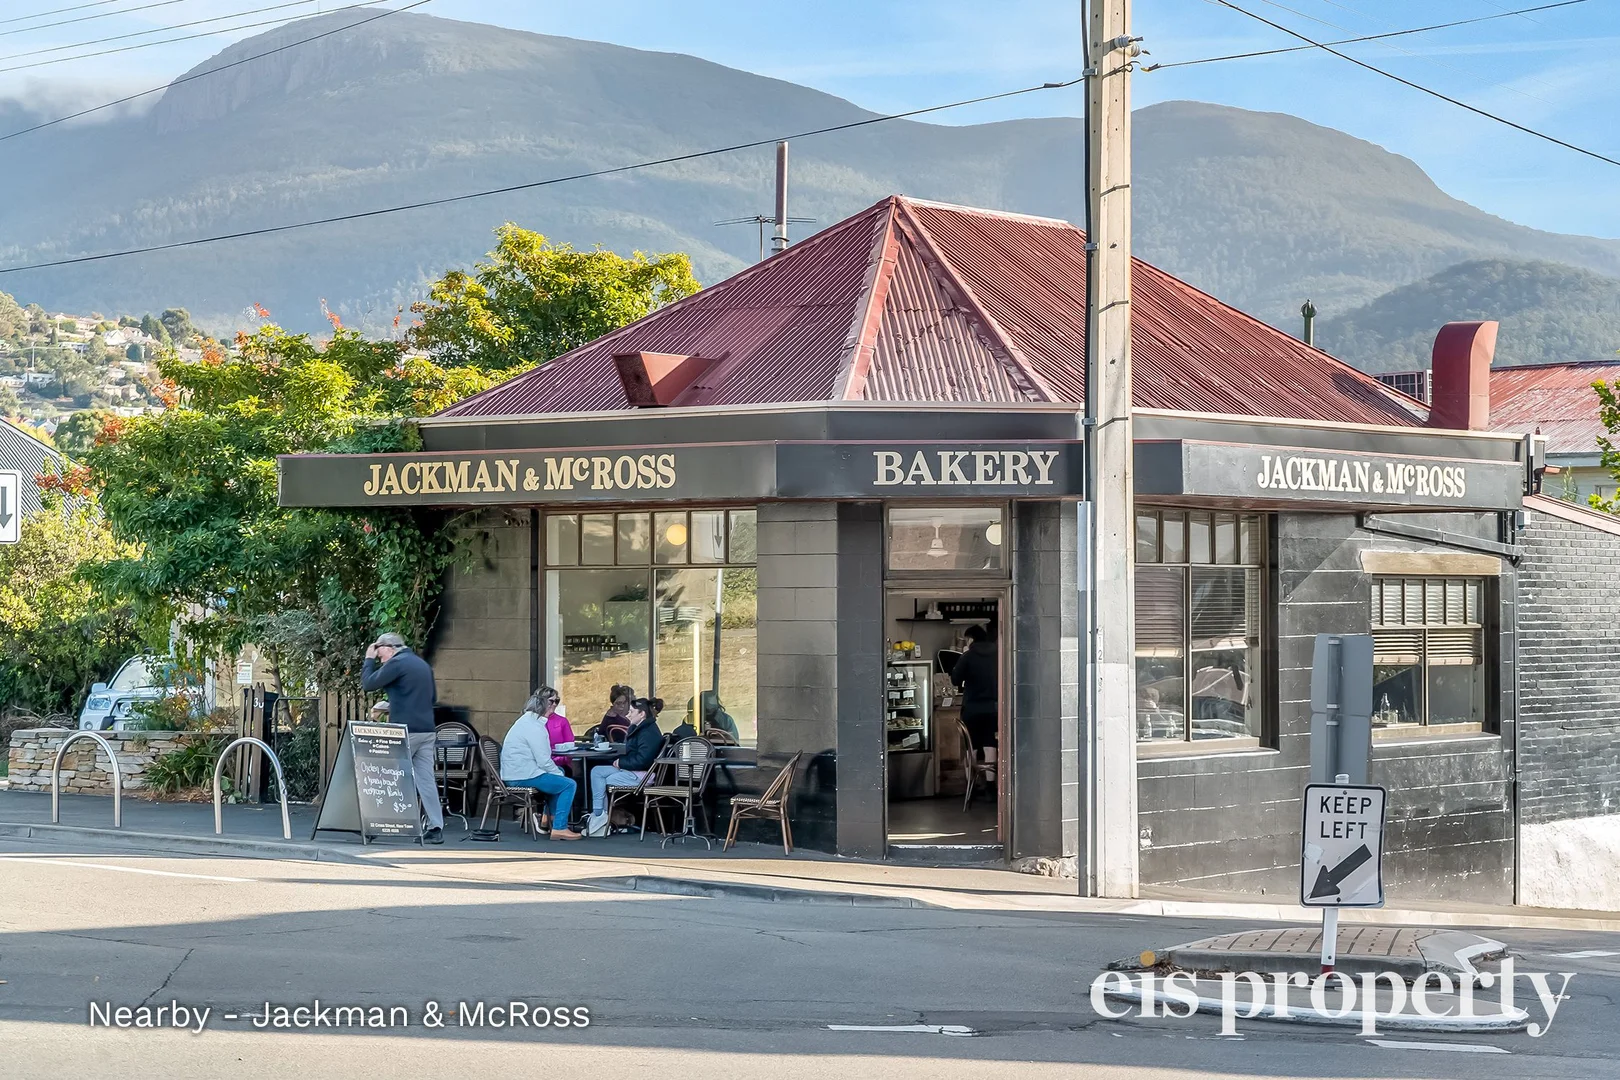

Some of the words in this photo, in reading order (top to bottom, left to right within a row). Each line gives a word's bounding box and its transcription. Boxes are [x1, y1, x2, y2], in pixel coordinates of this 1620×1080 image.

[363, 459, 520, 496] JACKMAN
[522, 467, 541, 492] &
[873, 450, 1060, 486] BAKERY
[1256, 455, 1371, 493] JACKMAN
[1372, 470, 1385, 494] &
[1320, 796, 1372, 815] KEEP
[1320, 821, 1368, 839] LEFT
